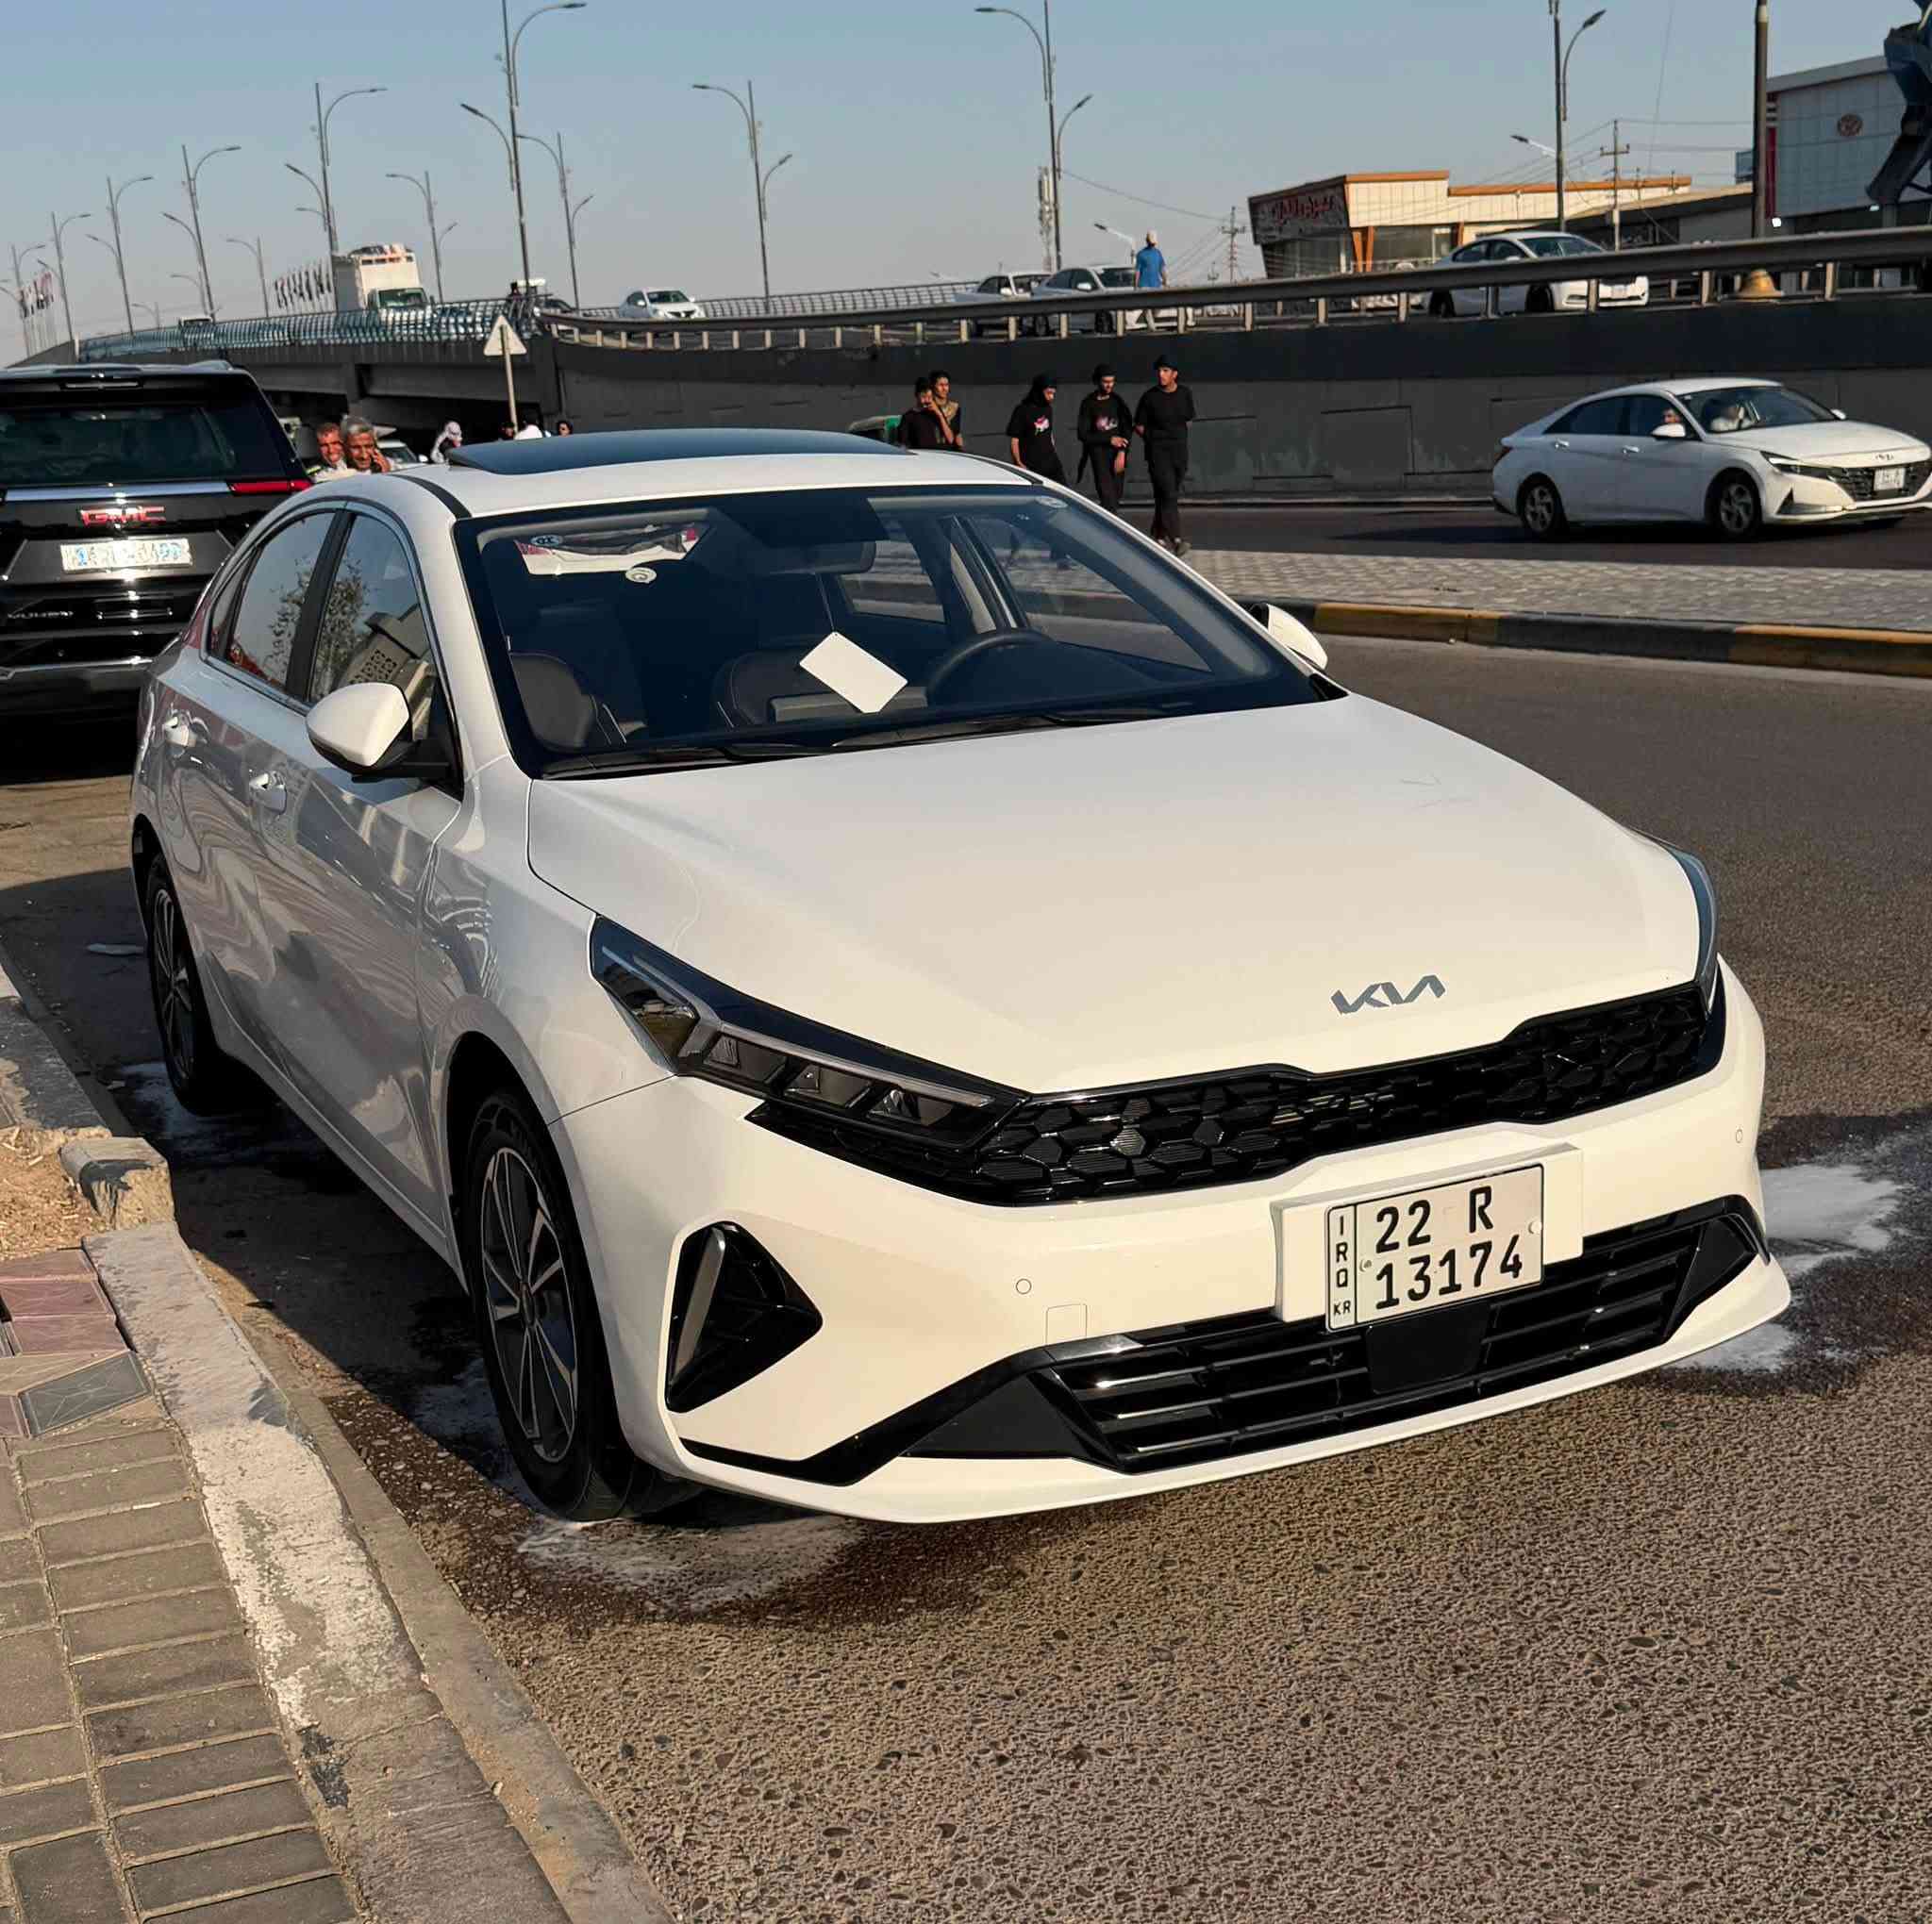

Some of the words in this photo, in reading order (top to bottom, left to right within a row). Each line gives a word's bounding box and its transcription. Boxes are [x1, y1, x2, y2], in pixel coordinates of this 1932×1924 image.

[1330, 975, 1445, 1014] KIA
[1375, 1200, 1431, 1253] 22
[1469, 1186, 1493, 1234] R
[1376, 1235, 1523, 1310] 13174
[1333, 1301, 1351, 1316] KR
